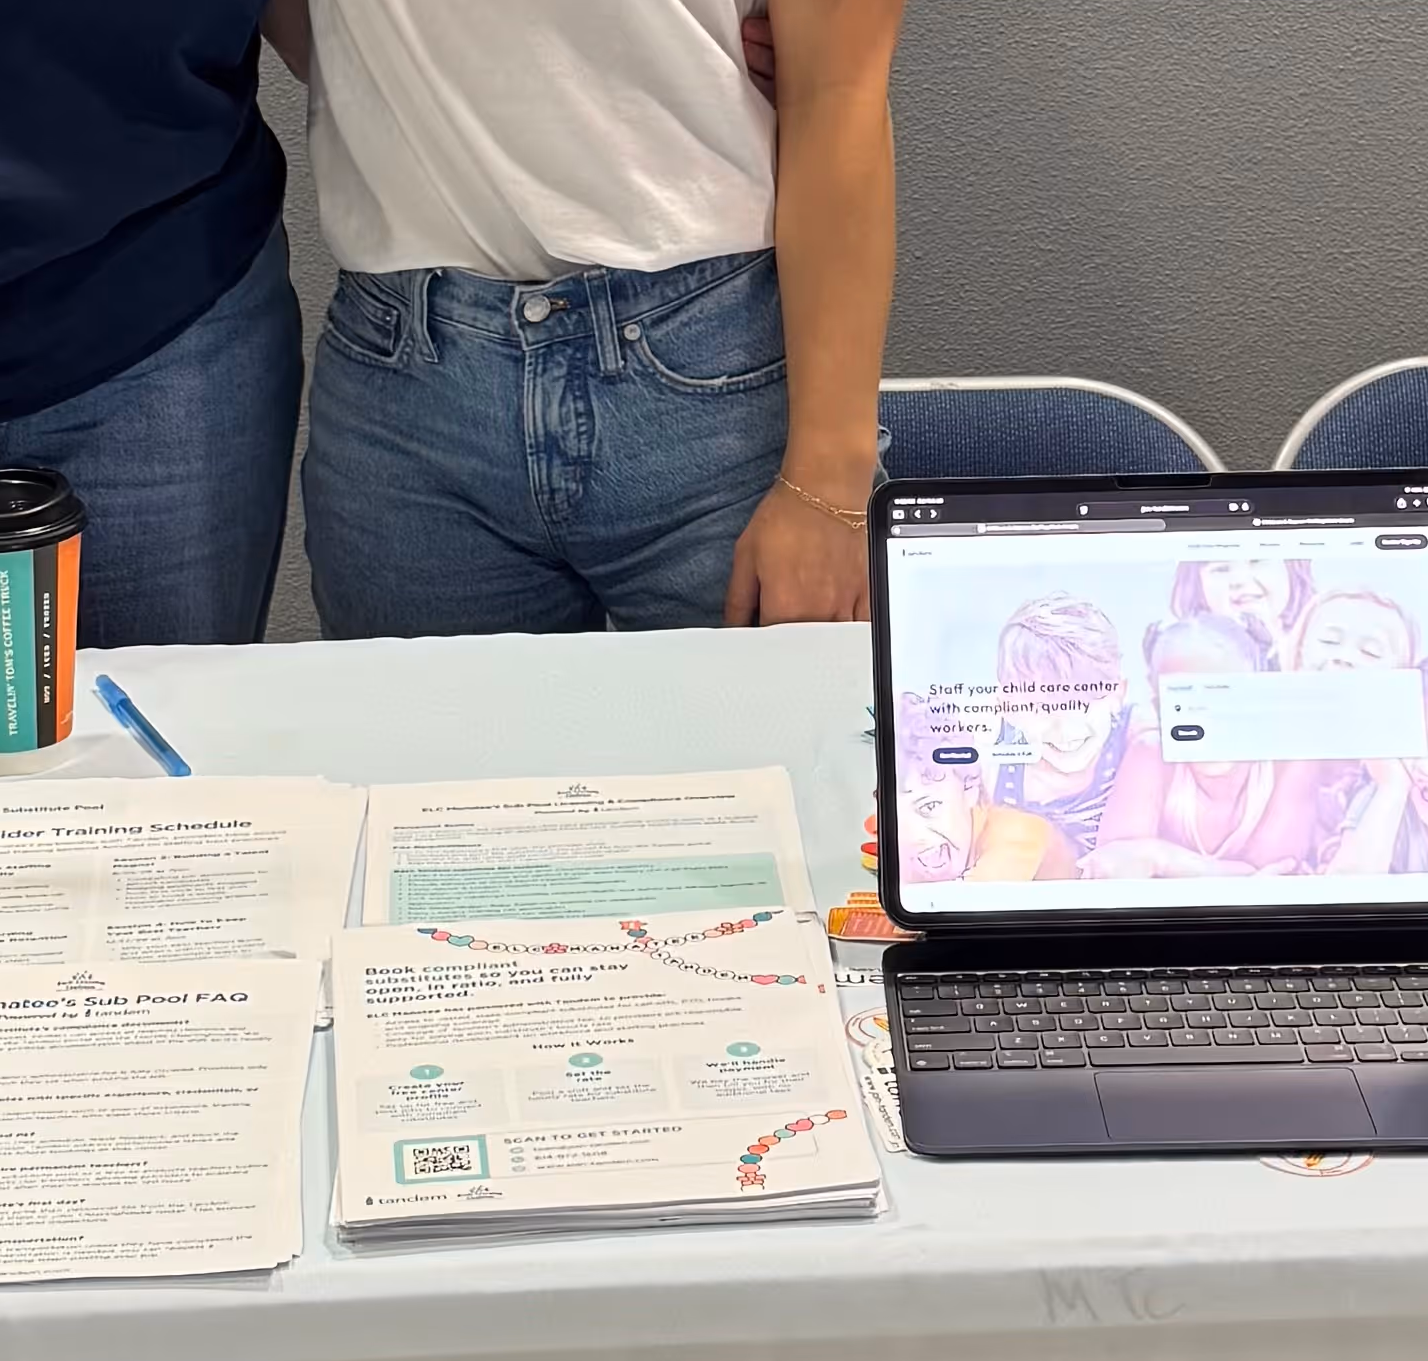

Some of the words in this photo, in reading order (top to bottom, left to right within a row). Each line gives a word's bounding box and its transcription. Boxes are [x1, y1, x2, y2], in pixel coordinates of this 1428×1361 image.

[0, 570, 9, 604] TRUCK
[2, 606, 14, 647] COFFEE
[930, 684, 963, 695] Staff
[968, 686, 998, 696] your
[1003, 682, 1035, 693] child
[1040, 684, 1070, 692] care
[1074, 681, 1118, 691] center
[930, 703, 960, 713] with
[964, 701, 1038, 715] compliant,
[1042, 700, 1089, 713] quality
[930, 722, 992, 733] workers.
[51, 824, 144, 840] Training
[149, 819, 252, 832] Schedule
[365, 966, 414, 976] Book
[422, 960, 518, 974] compliant
[365, 973, 473, 985] substitutes
[479, 971, 501, 980] so
[508, 968, 543, 978] you
[549, 965, 583, 974] can
[589, 963, 629, 973] stay
[365, 985, 421, 996] open,
[428, 983, 441, 991] in
[444, 980, 502, 990] ratio,
[509, 976, 544, 985] and
[551, 973, 593, 983] fully
[84, 994, 129, 1009] Sub
[138, 993, 189, 1007] Pool
[195, 992, 249, 1004] FAQ
[366, 990, 474, 1005] supported.
[504, 1136, 546, 1145] SCAN
[577, 1131, 606, 1139] GET
[612, 1126, 682, 1136] STARTED
[378, 1194, 447, 1205] tandem
